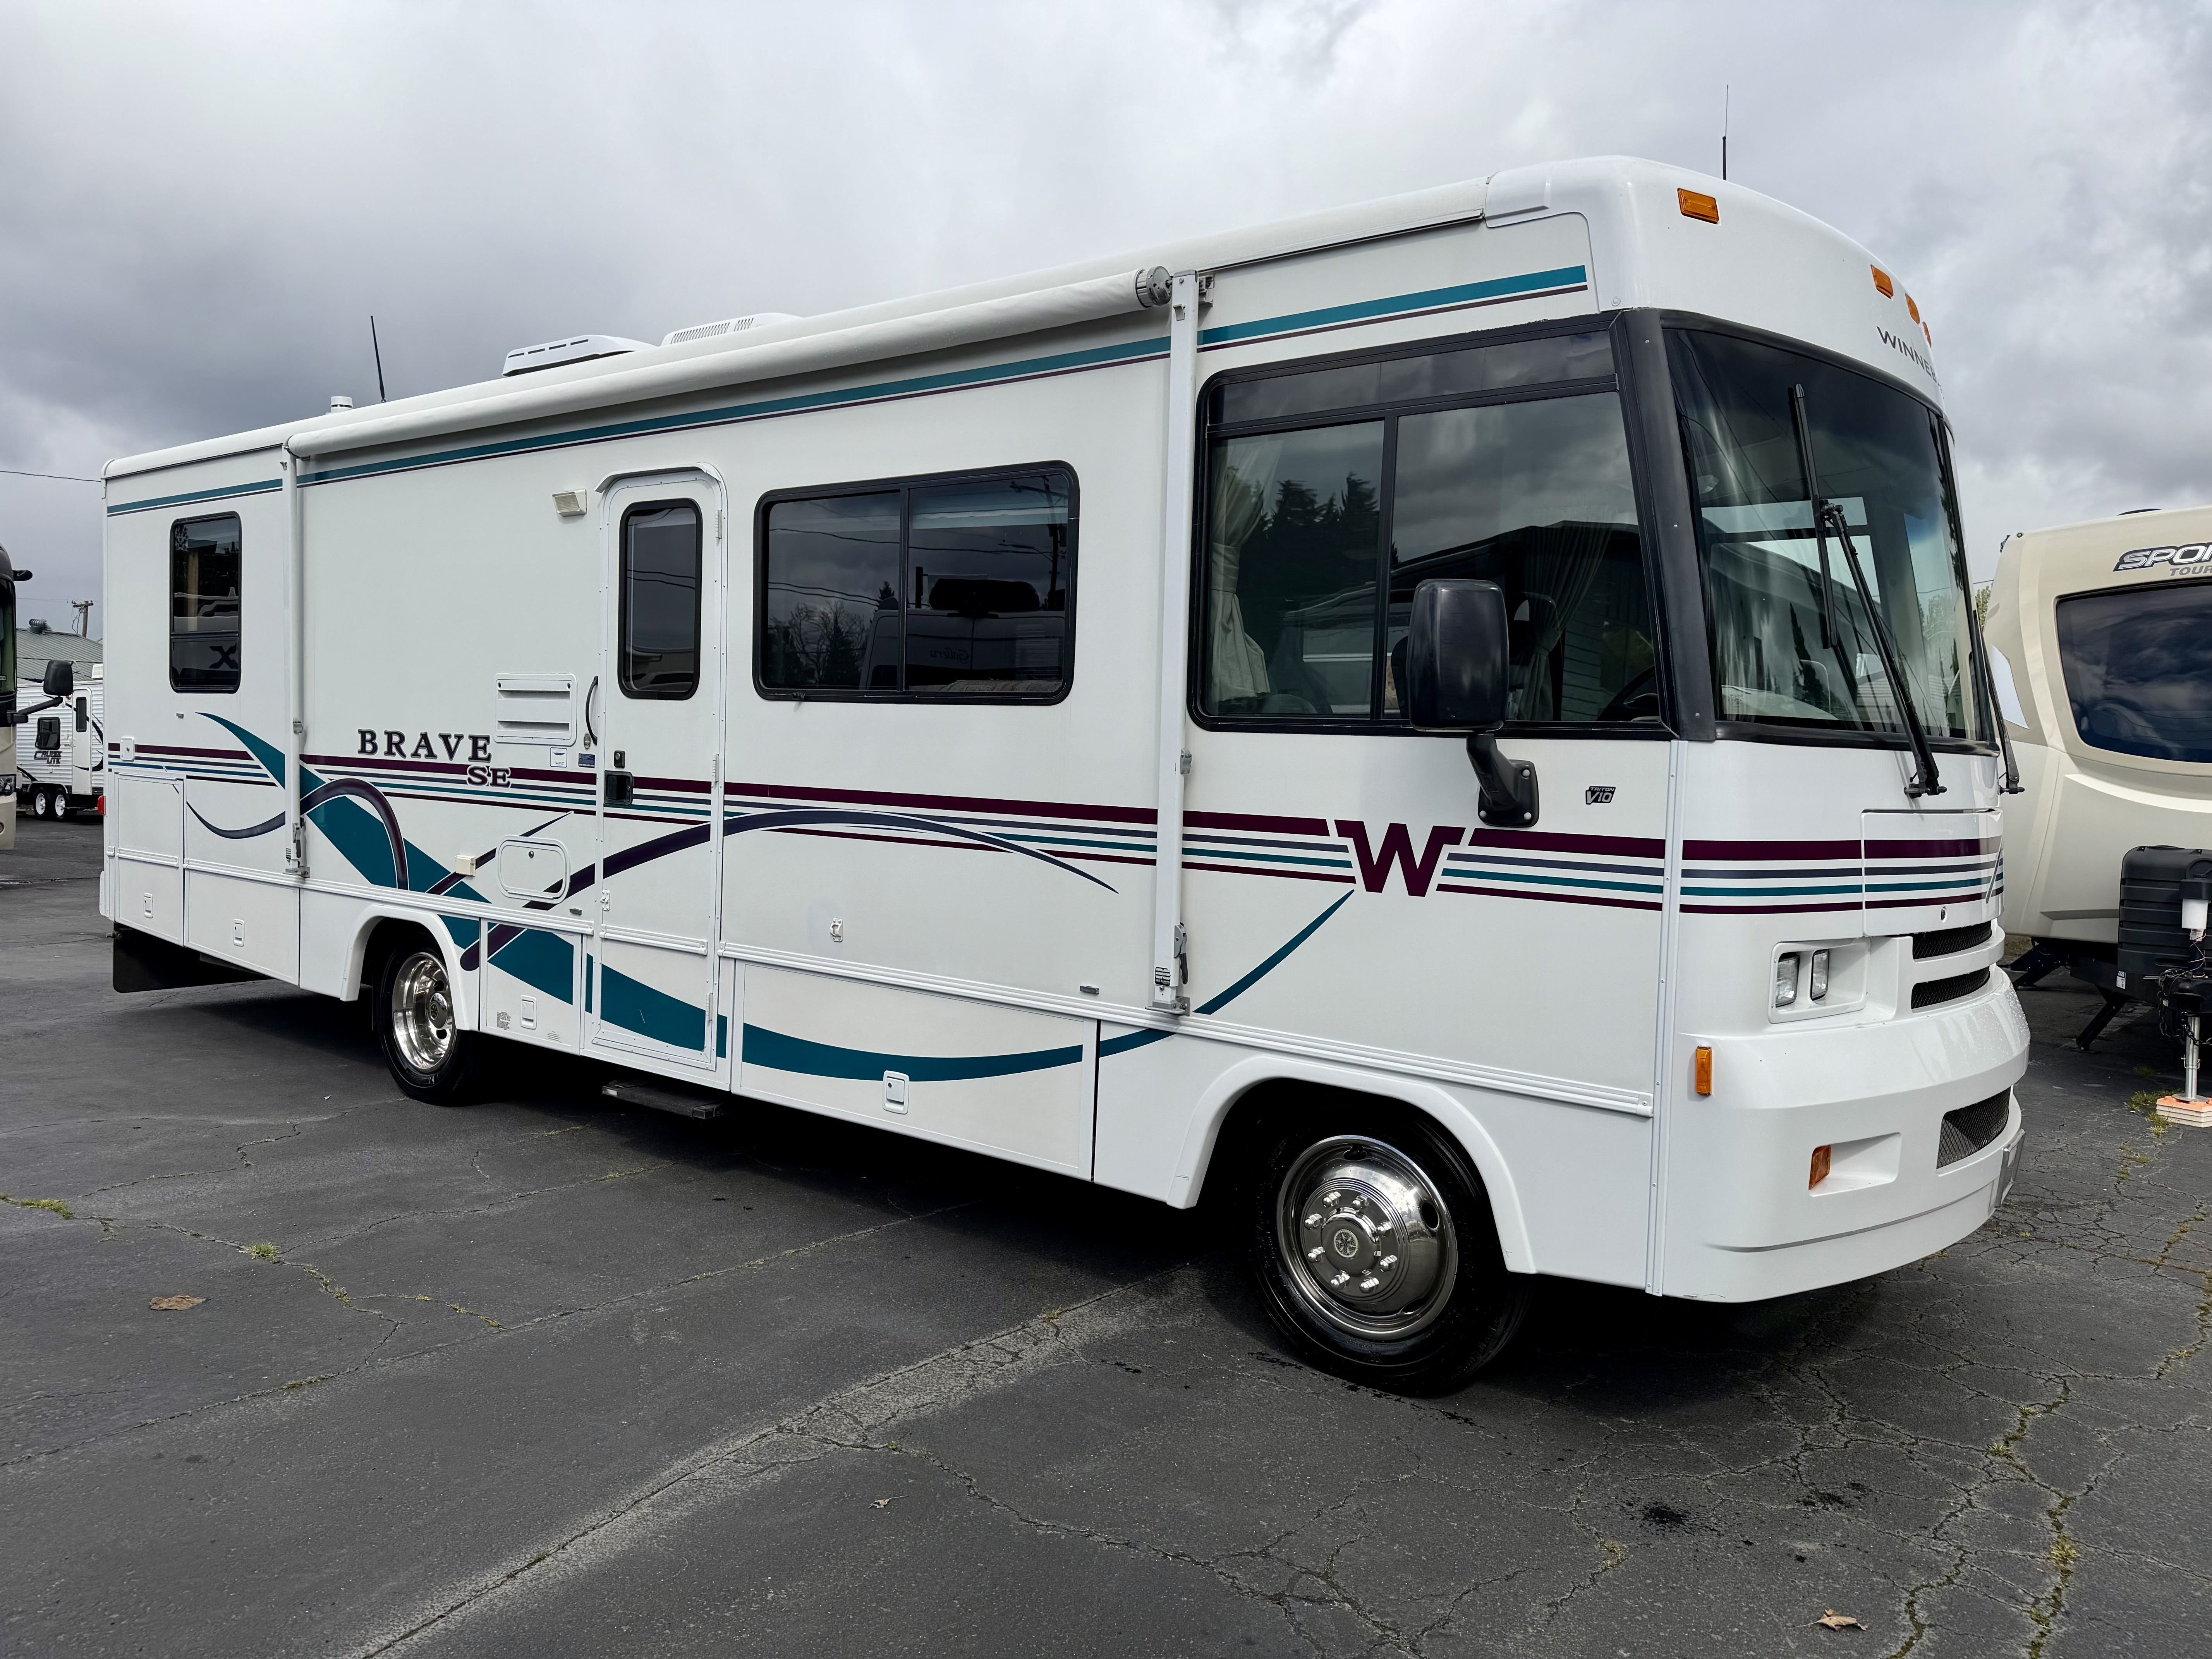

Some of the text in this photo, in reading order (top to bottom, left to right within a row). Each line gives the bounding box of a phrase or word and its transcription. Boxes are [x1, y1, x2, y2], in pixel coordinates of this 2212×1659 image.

[1876, 326, 1942, 393] WINNEB
[358, 728, 492, 763] BRAVE
[467, 766, 510, 787] SE
[1587, 791, 1612, 804] V10
[1334, 819, 1466, 897] W
